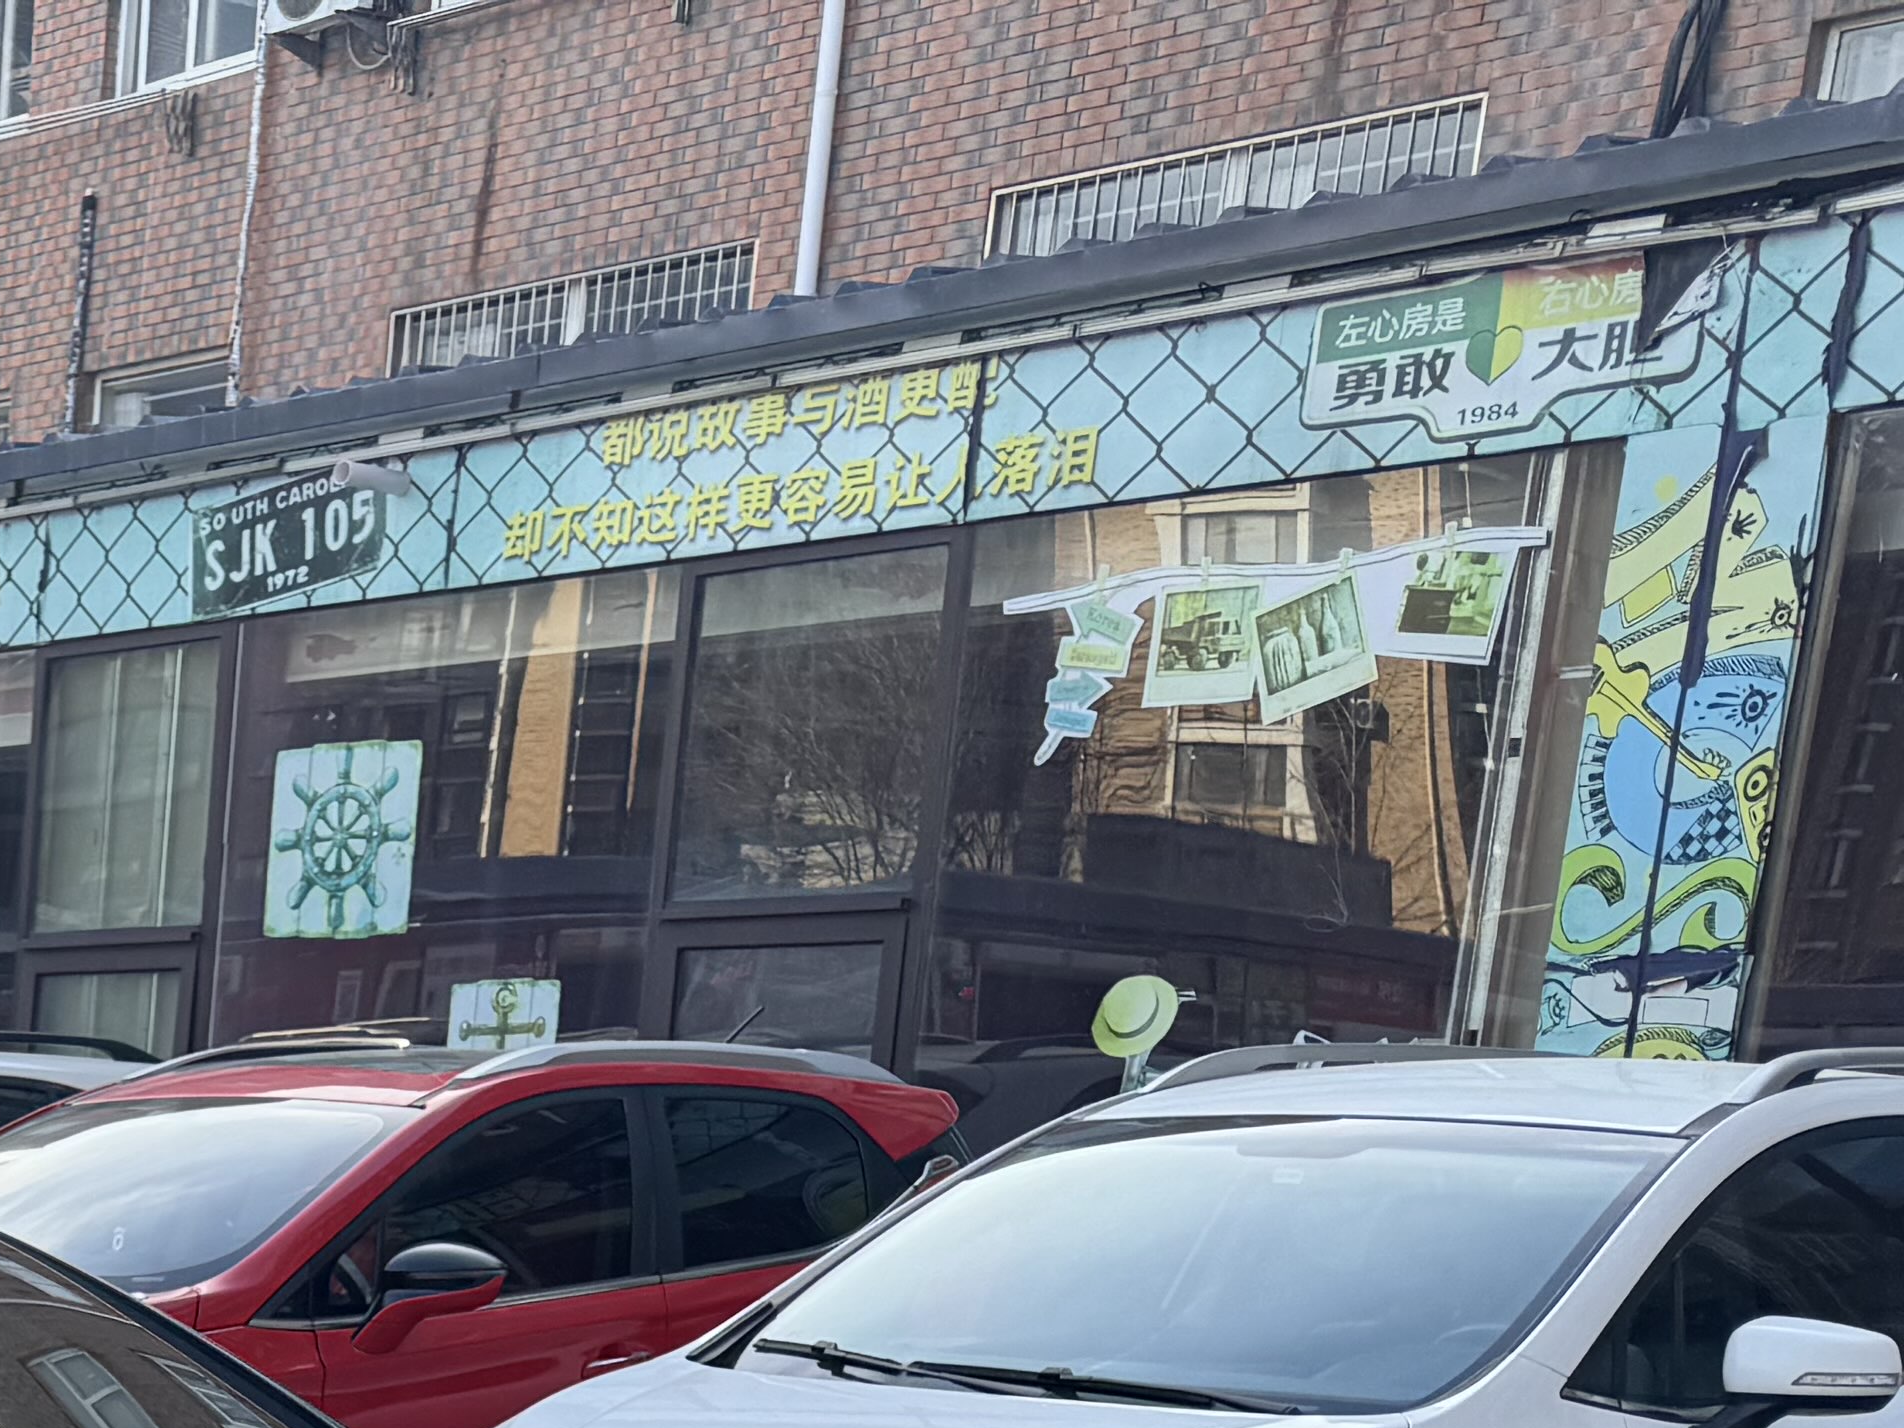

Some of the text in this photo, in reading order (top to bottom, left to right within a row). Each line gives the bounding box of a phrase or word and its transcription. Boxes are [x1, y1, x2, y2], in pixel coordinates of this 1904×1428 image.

[1335, 297, 1466, 349] 左心房是
[1329, 347, 1456, 412] 勇敢
[1457, 401, 1519, 427] 1984
[204, 489, 375, 592] SJK 105
[267, 566, 309, 592] 1972
